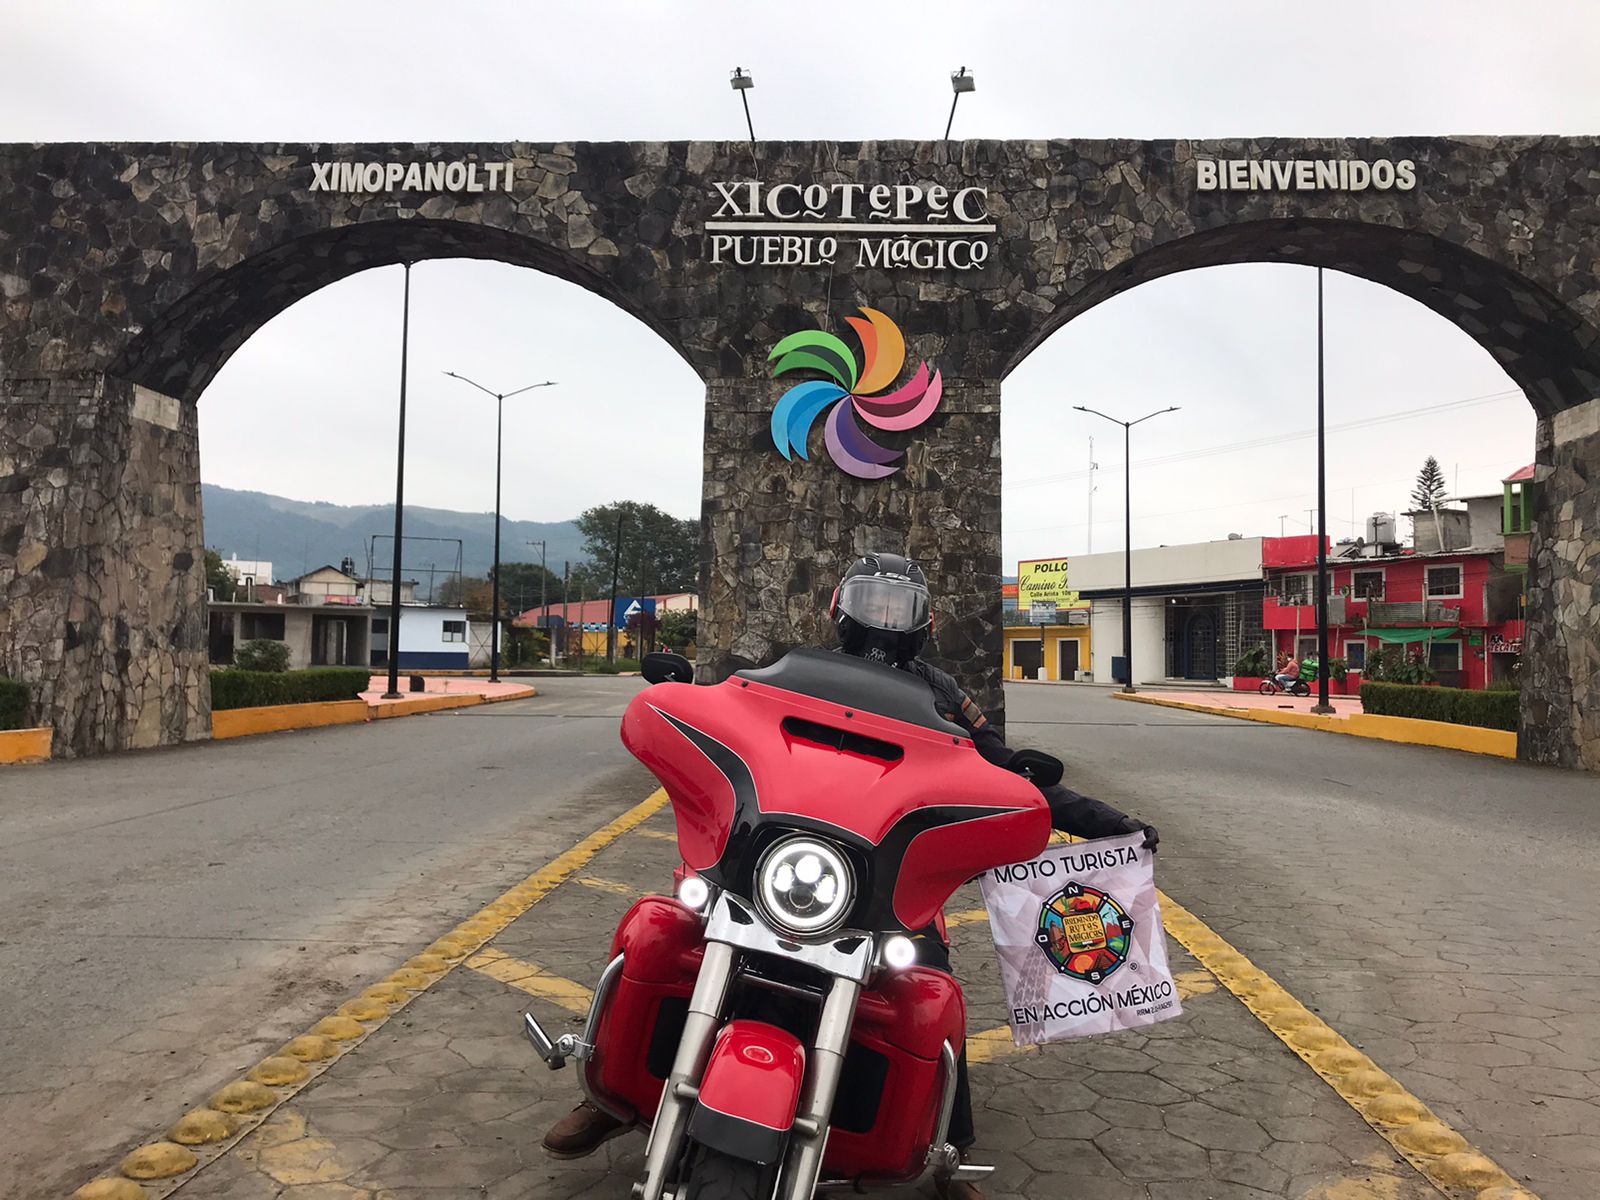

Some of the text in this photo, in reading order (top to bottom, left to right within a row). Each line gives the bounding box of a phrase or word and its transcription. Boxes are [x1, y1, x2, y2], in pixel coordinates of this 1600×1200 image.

[308, 161, 514, 193] XIMOPANOLTI
[1196, 159, 1417, 191] BIENVENIDOS
[994, 846, 1138, 883] MOTO TURISTA
[1068, 885, 1079, 895] N
[1013, 1007, 1038, 1025] EN
[1043, 992, 1113, 1021] ACCIÓN
[1116, 980, 1172, 1009] MÉXICO
